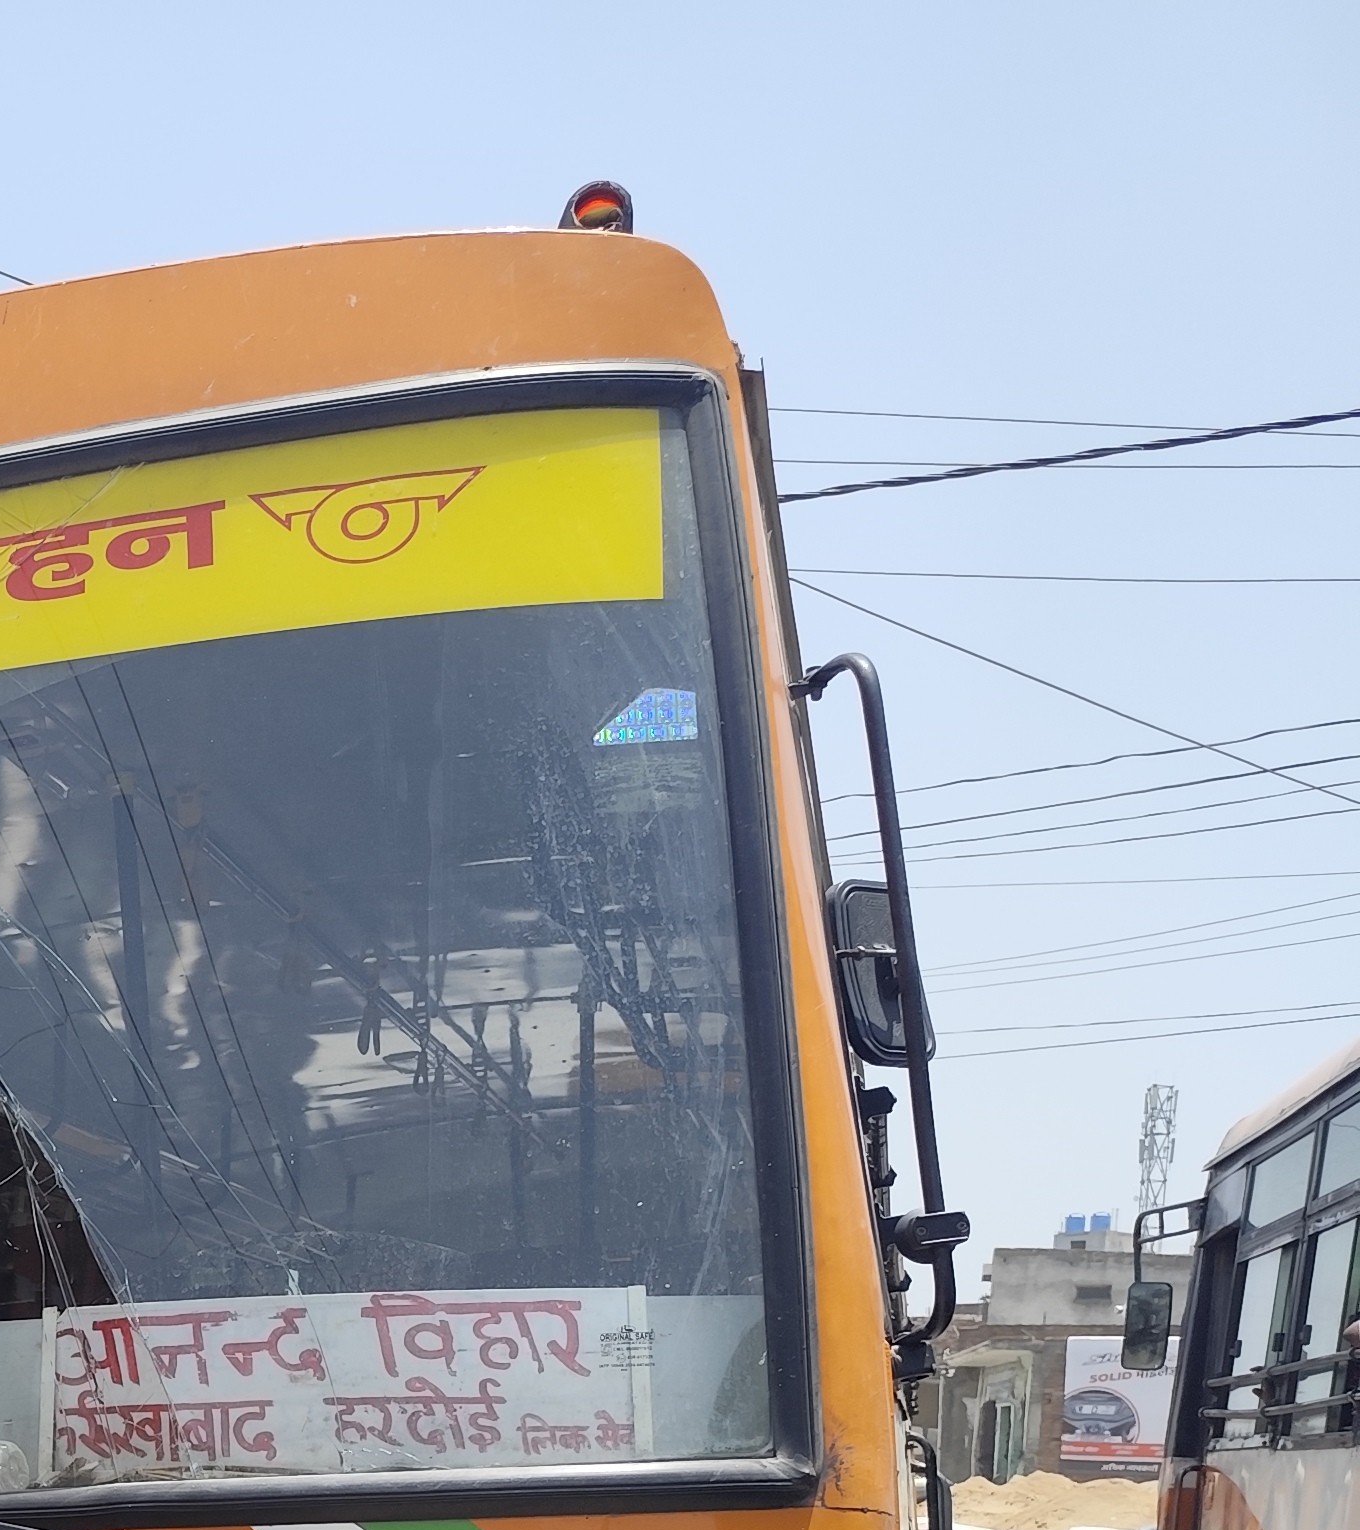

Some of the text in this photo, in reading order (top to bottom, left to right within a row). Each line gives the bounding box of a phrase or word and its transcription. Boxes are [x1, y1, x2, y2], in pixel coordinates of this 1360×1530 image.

[56, 1294, 591, 1387] आनन्द विहार
[1088, 1371, 1132, 1384] SOLID
[323, 1376, 507, 1453] हरदोई
